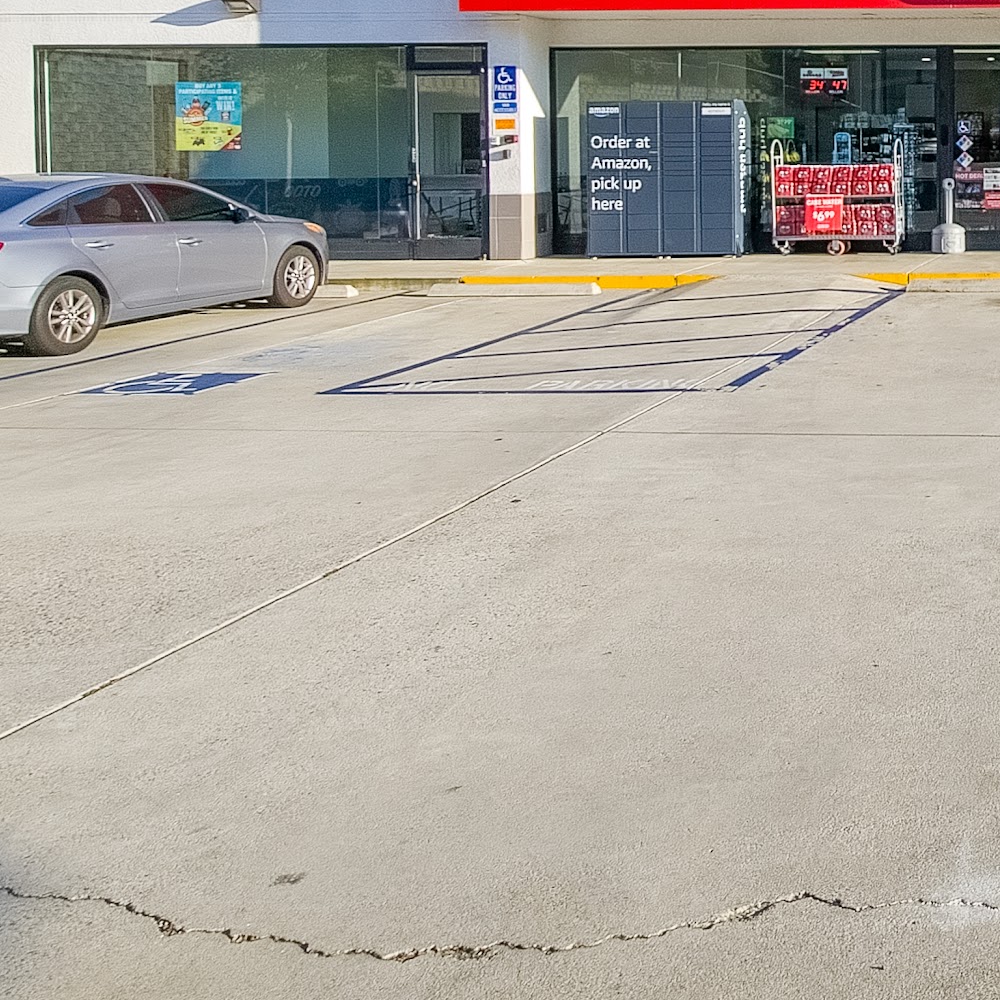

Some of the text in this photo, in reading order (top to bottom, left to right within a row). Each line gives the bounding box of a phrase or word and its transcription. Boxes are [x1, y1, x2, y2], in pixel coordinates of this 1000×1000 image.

[809, 79, 848, 90] 34 47
[588, 106, 620, 115] amazon
[590, 135, 651, 149] Order at
[590, 156, 652, 172] Amazon,
[591, 176, 642, 193] pick up
[591, 197, 624, 211] here
